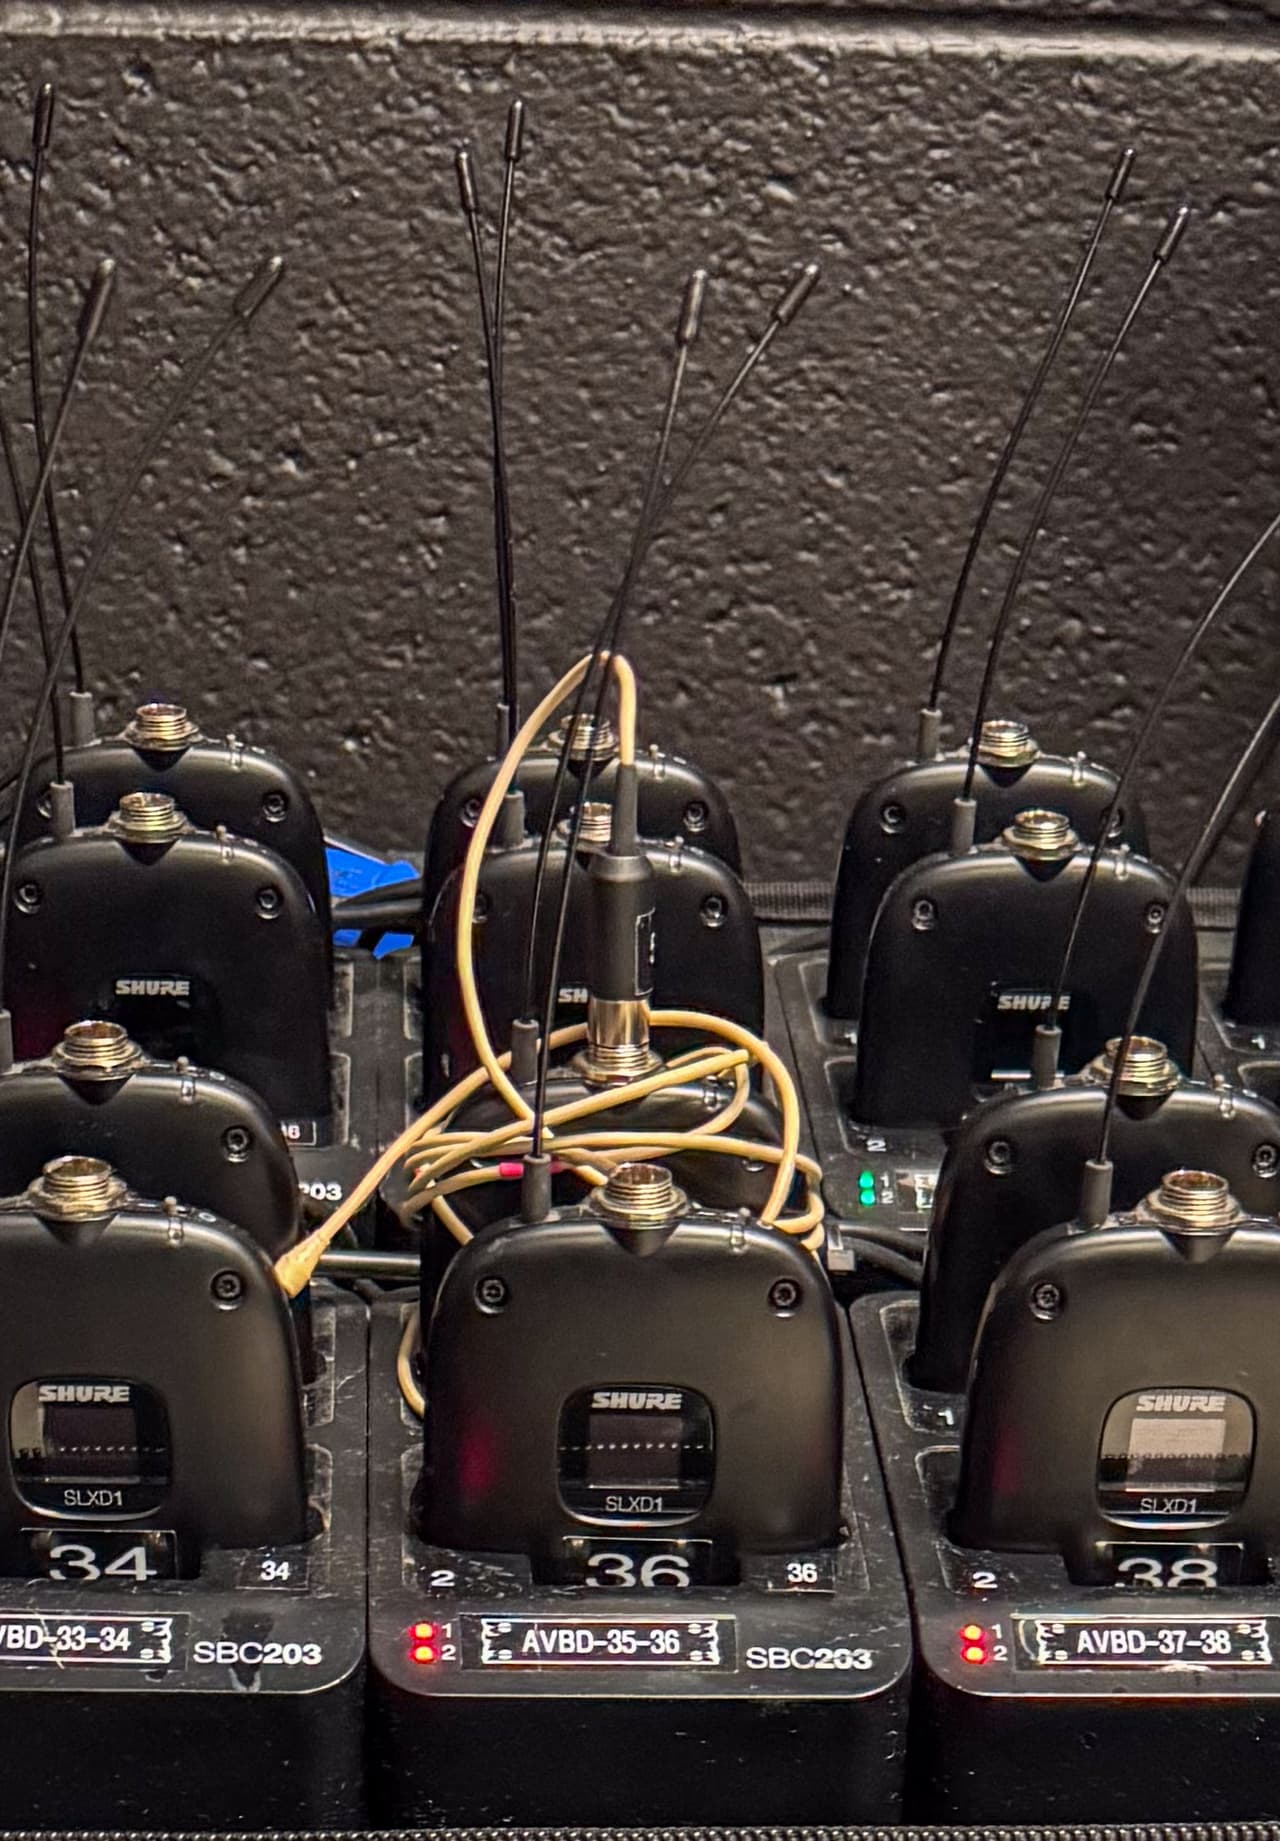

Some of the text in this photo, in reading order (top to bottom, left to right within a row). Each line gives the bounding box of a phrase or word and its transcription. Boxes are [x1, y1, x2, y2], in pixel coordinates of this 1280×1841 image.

[115, 979, 190, 996] SHURE
[866, 1139, 887, 1152] 2
[880, 1171, 890, 1187] 1
[881, 1190, 894, 1204] 2
[38, 1385, 130, 1402] SHURE
[590, 1391, 682, 1410] SHURE
[1136, 1395, 1225, 1412] SHURE
[63, 1489, 123, 1507] SLXD1
[604, 1496, 663, 1513] SLXD1
[1139, 1498, 1198, 1514] SLXD1
[48, 1544, 157, 1581] 34
[260, 1561, 290, 1580] 34
[586, 1552, 691, 1587] 36
[430, 1570, 455, 1587] 2
[786, 1562, 817, 1583] 36
[971, 1572, 997, 1590] 2
[1117, 1557, 1219, 1588] 38
[441, 1624, 453, 1638] 1
[991, 1624, 1003, 1638] 1
[521, 1628, 680, 1654] AVBD-35-36
[1076, 1629, 1232, 1655] AVBD-37-38
[193, 1642, 322, 1665] SBC203
[441, 1645, 457, 1661] 2
[746, 1648, 872, 1671] SBC203
[992, 1645, 1008, 1661] 2
